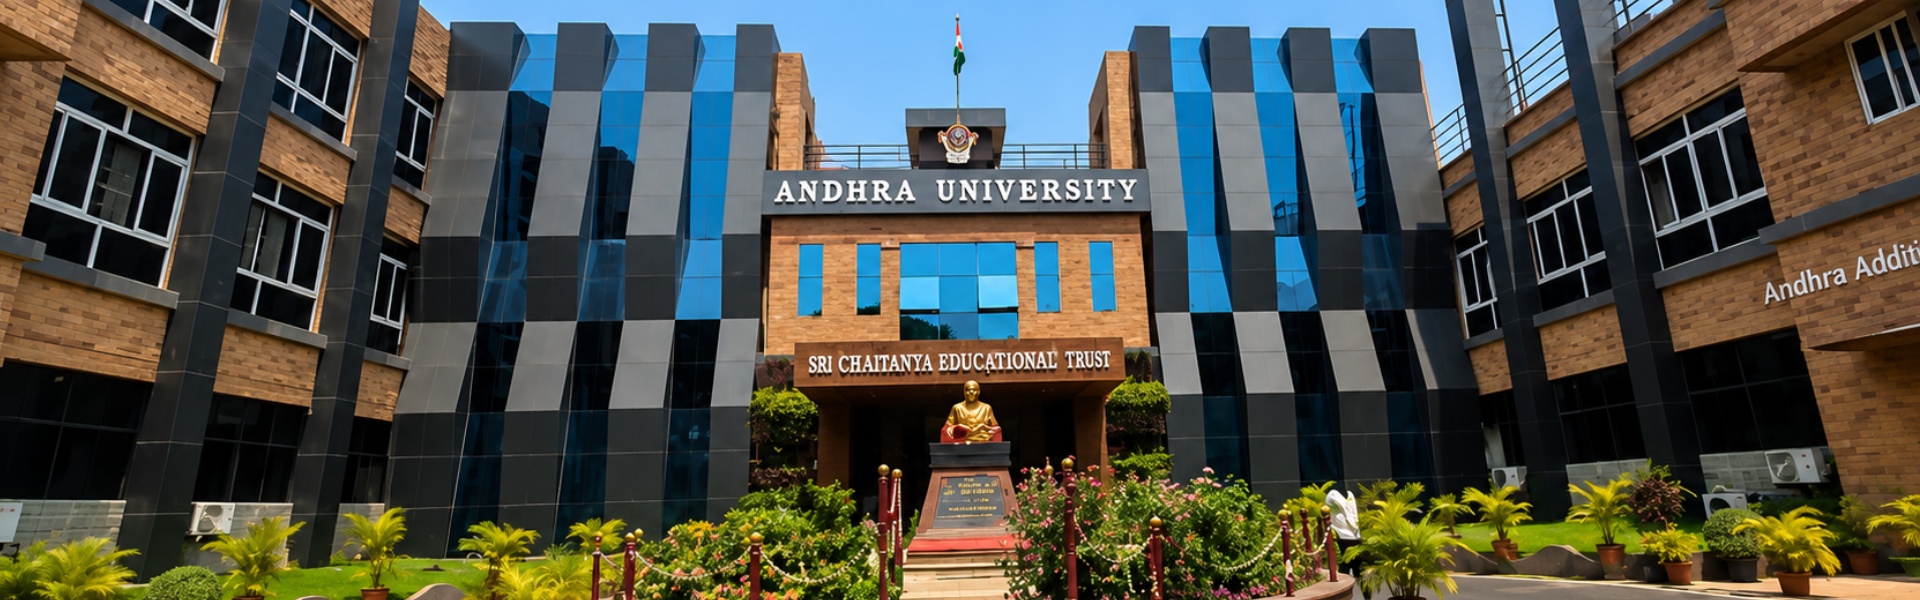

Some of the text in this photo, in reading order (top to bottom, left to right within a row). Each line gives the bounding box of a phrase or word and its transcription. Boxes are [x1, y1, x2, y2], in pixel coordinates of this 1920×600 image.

[773, 178, 1138, 203] ANDHRA UNIVERSITY
[1764, 268, 1848, 305] Andhra
[808, 350, 1112, 375] SRI CHAITANYA EDUCATIONAL TRUST
